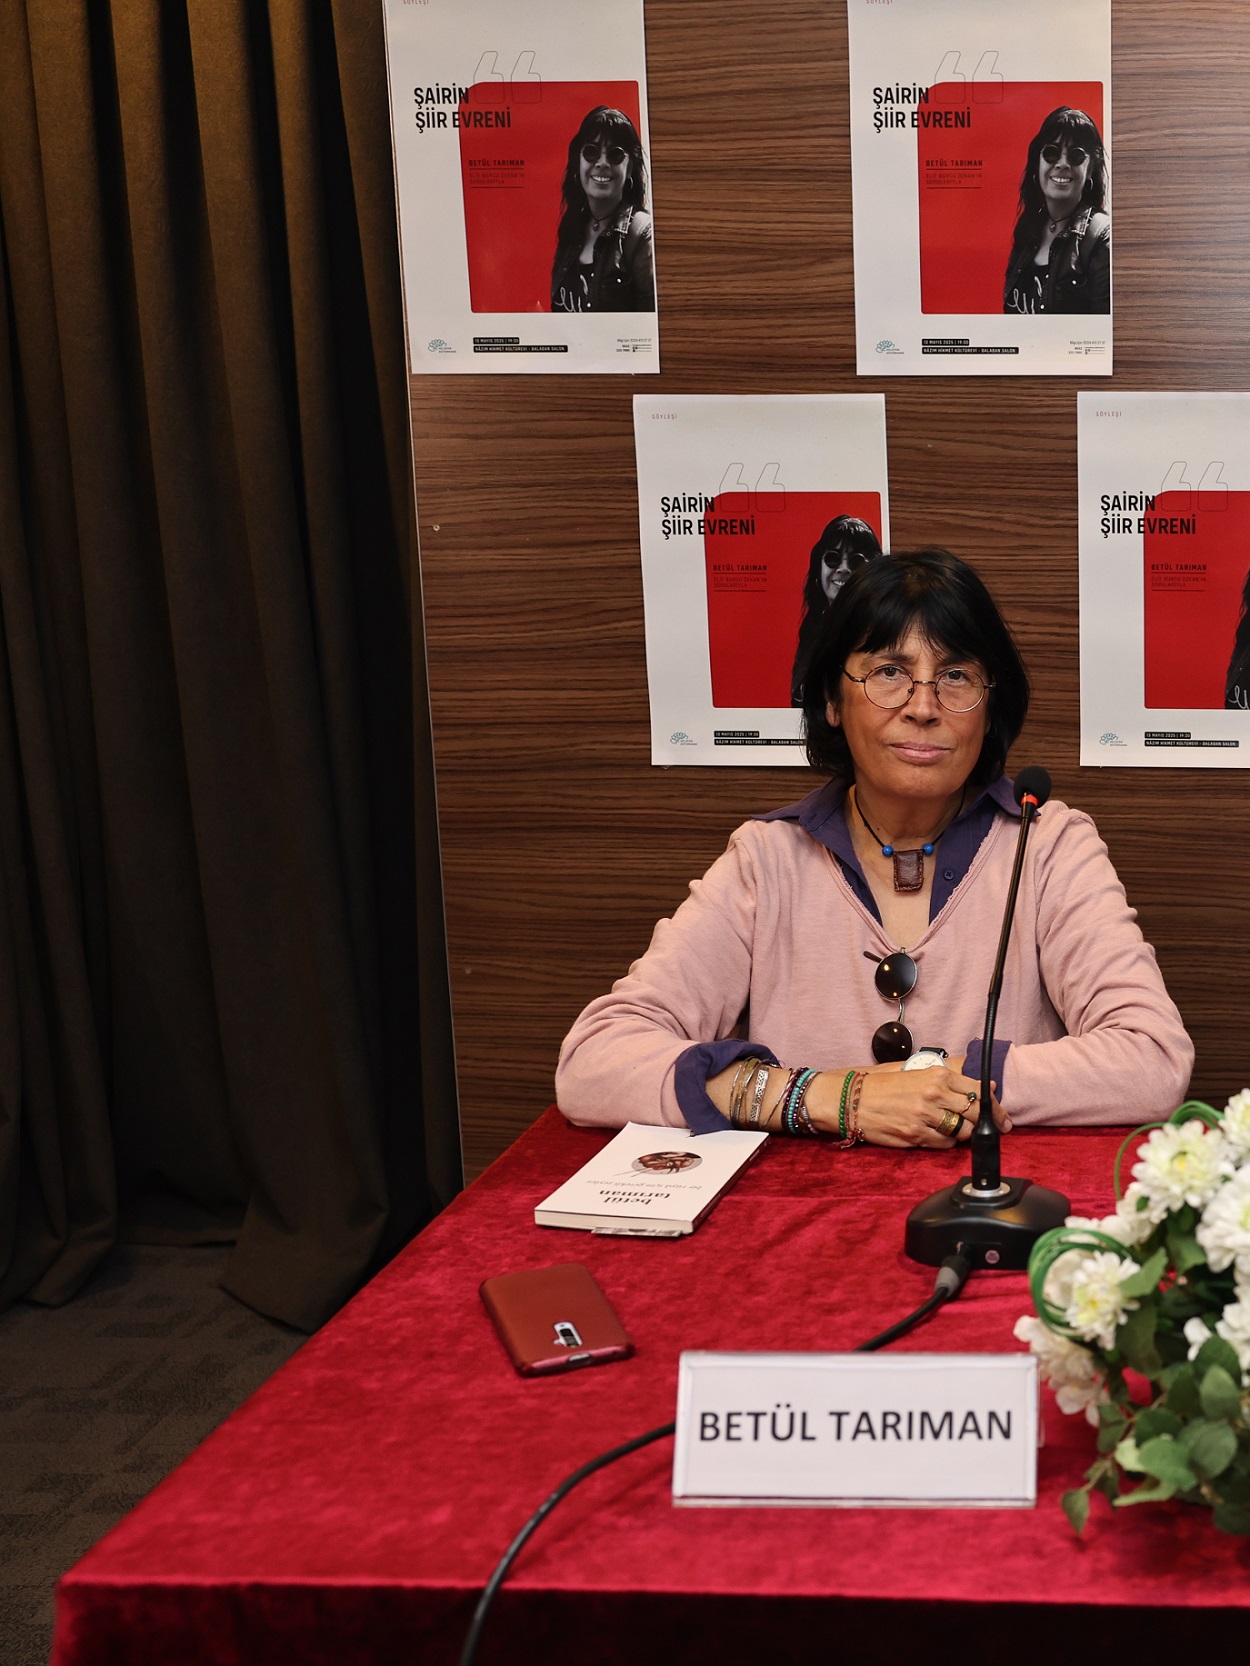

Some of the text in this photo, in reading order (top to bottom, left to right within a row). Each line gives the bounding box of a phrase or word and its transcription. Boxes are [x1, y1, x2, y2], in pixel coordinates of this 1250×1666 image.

[414, 82, 470, 110] ŞAİRİN
[873, 82, 930, 109] ŞAİRİN
[415, 106, 512, 133] ŞİİR EVRENİ
[873, 106, 971, 133] ŞİİR EVRENİ
[469, 158, 524, 167] BETÜL TARIMAN
[926, 158, 983, 167] BETÜL TARIMAN
[661, 492, 715, 517] ŞAİRİN
[1101, 491, 1156, 516] ŞAİRİN
[662, 514, 756, 540] ŞİİR EVRENİ
[1101, 513, 1196, 538] ŞİİR EVRENİ
[713, 563, 734, 571] BETÜL
[1151, 562, 1173, 570] BETÜL
[599, 1190, 671, 1199] tarıman
[604, 1196, 652, 1206] betül
[699, 1404, 1012, 1442] BETÜL TARIMAN
